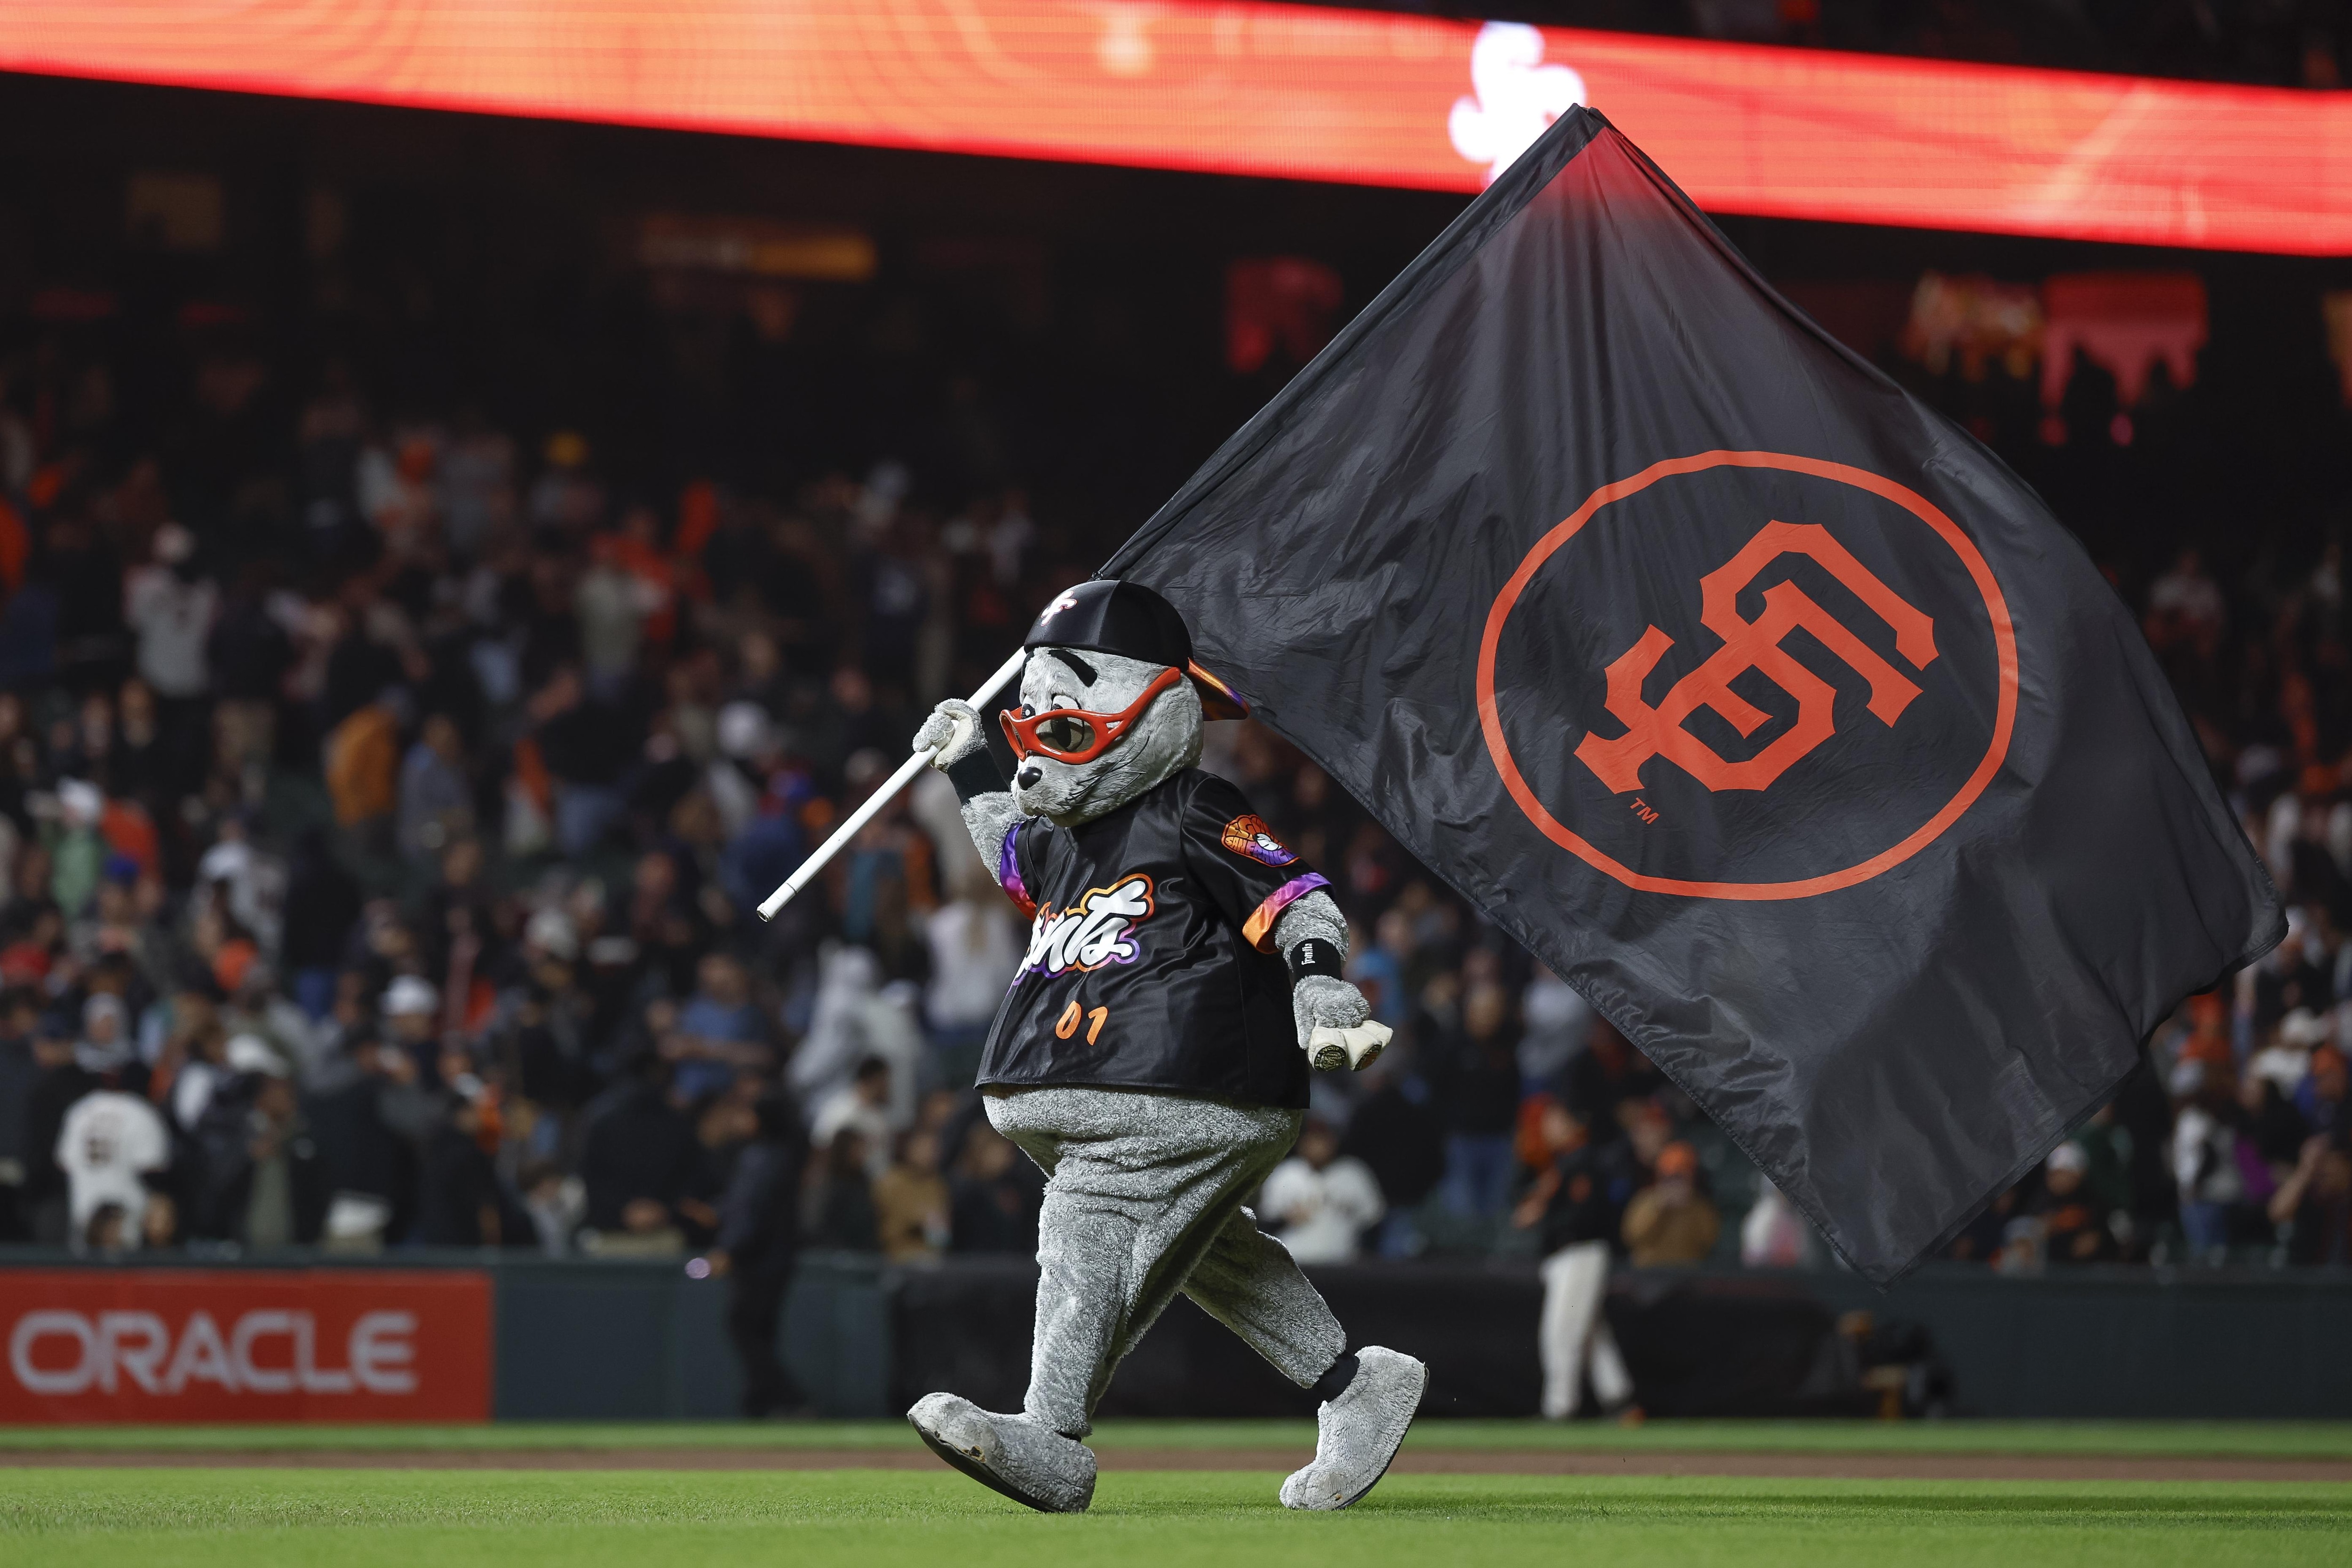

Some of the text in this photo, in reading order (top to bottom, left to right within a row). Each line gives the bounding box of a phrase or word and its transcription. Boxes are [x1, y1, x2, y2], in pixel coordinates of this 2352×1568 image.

[1573, 519, 1939, 794] SF
[1629, 797, 1660, 824] TM
[1225, 836, 1247, 855] SAN
[1055, 1000, 1108, 1046] 01
[8, 1309, 419, 1395] ORACLE
